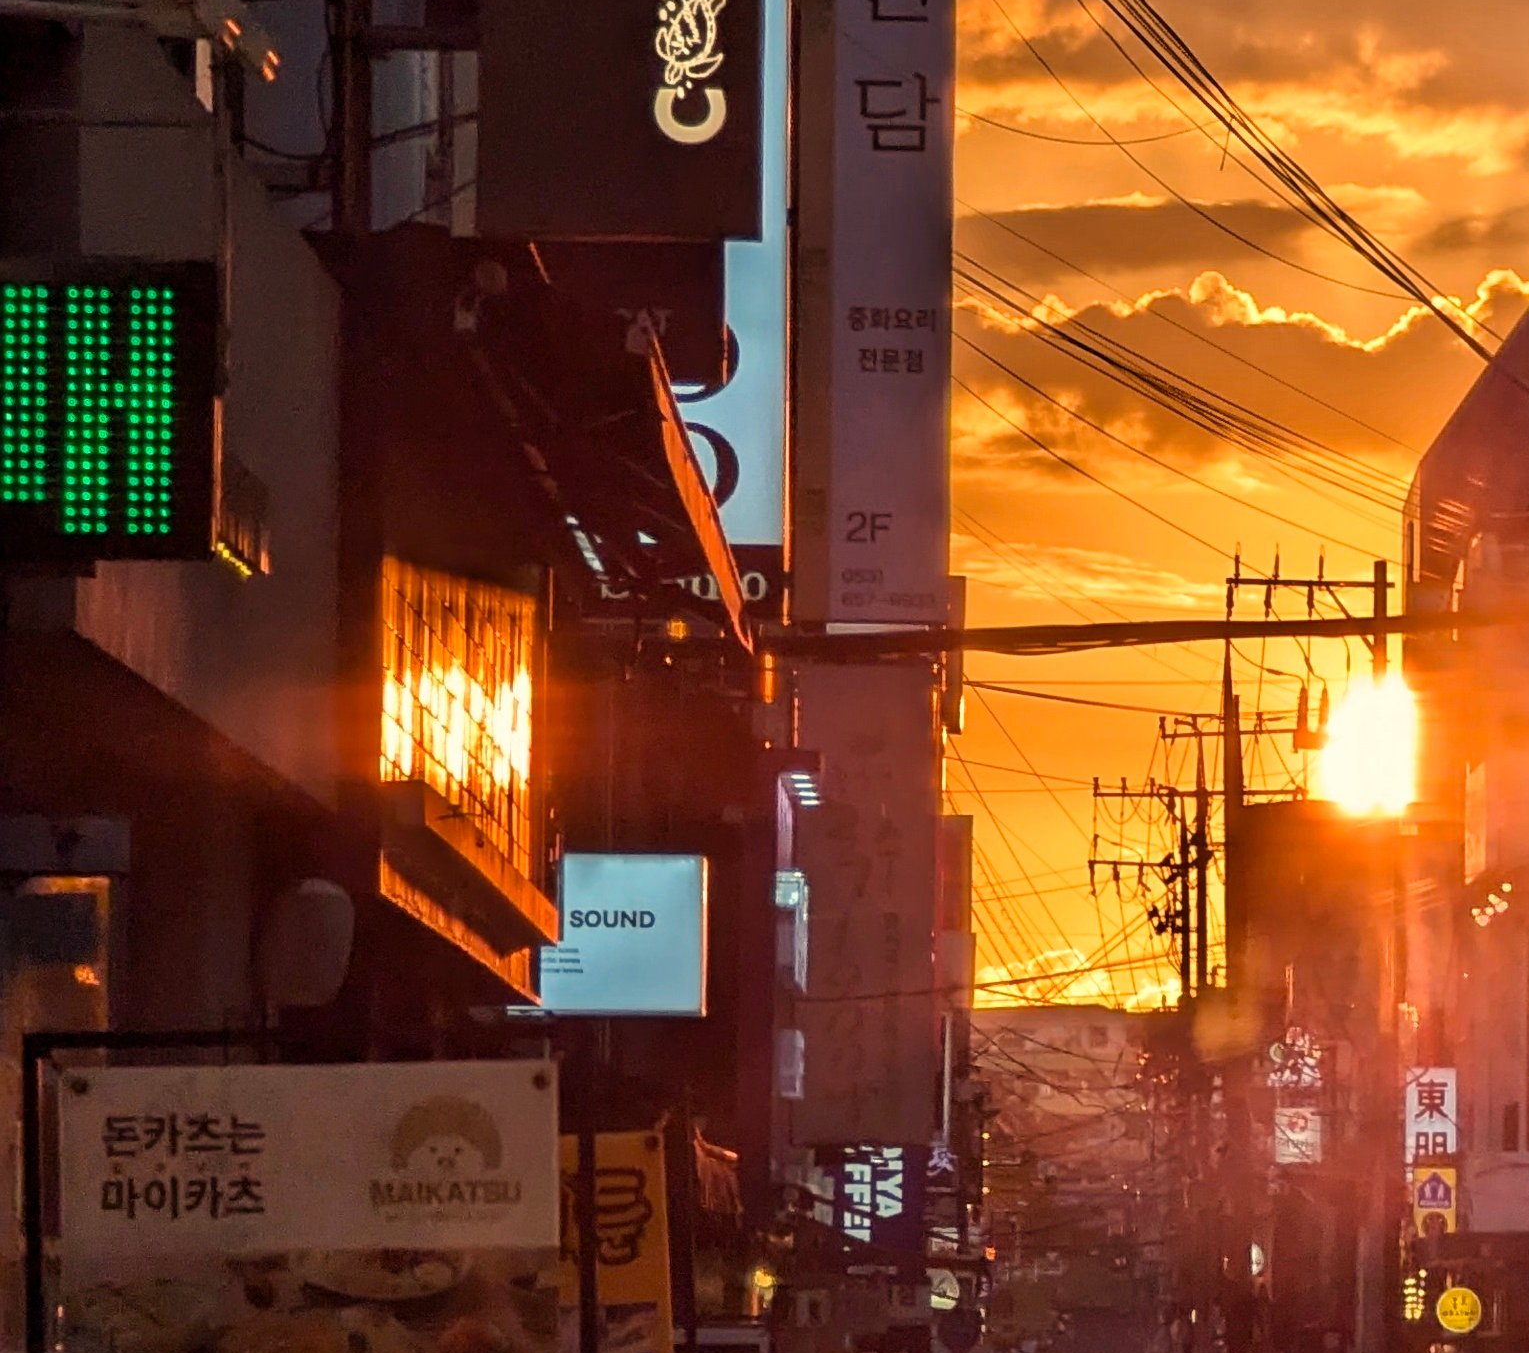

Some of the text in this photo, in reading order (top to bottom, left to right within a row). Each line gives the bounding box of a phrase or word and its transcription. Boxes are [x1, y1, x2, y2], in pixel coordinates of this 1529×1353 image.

[847, 305, 938, 334] 중화요리
[858, 348, 926, 374] 전문점
[846, 511, 893, 543] 2F
[569, 910, 656, 929] SOUND
[101, 1113, 266, 1157] 돈카츠는
[100, 1175, 266, 1220] 마이카츠
[368, 1178, 523, 1208] MAIKATSU
